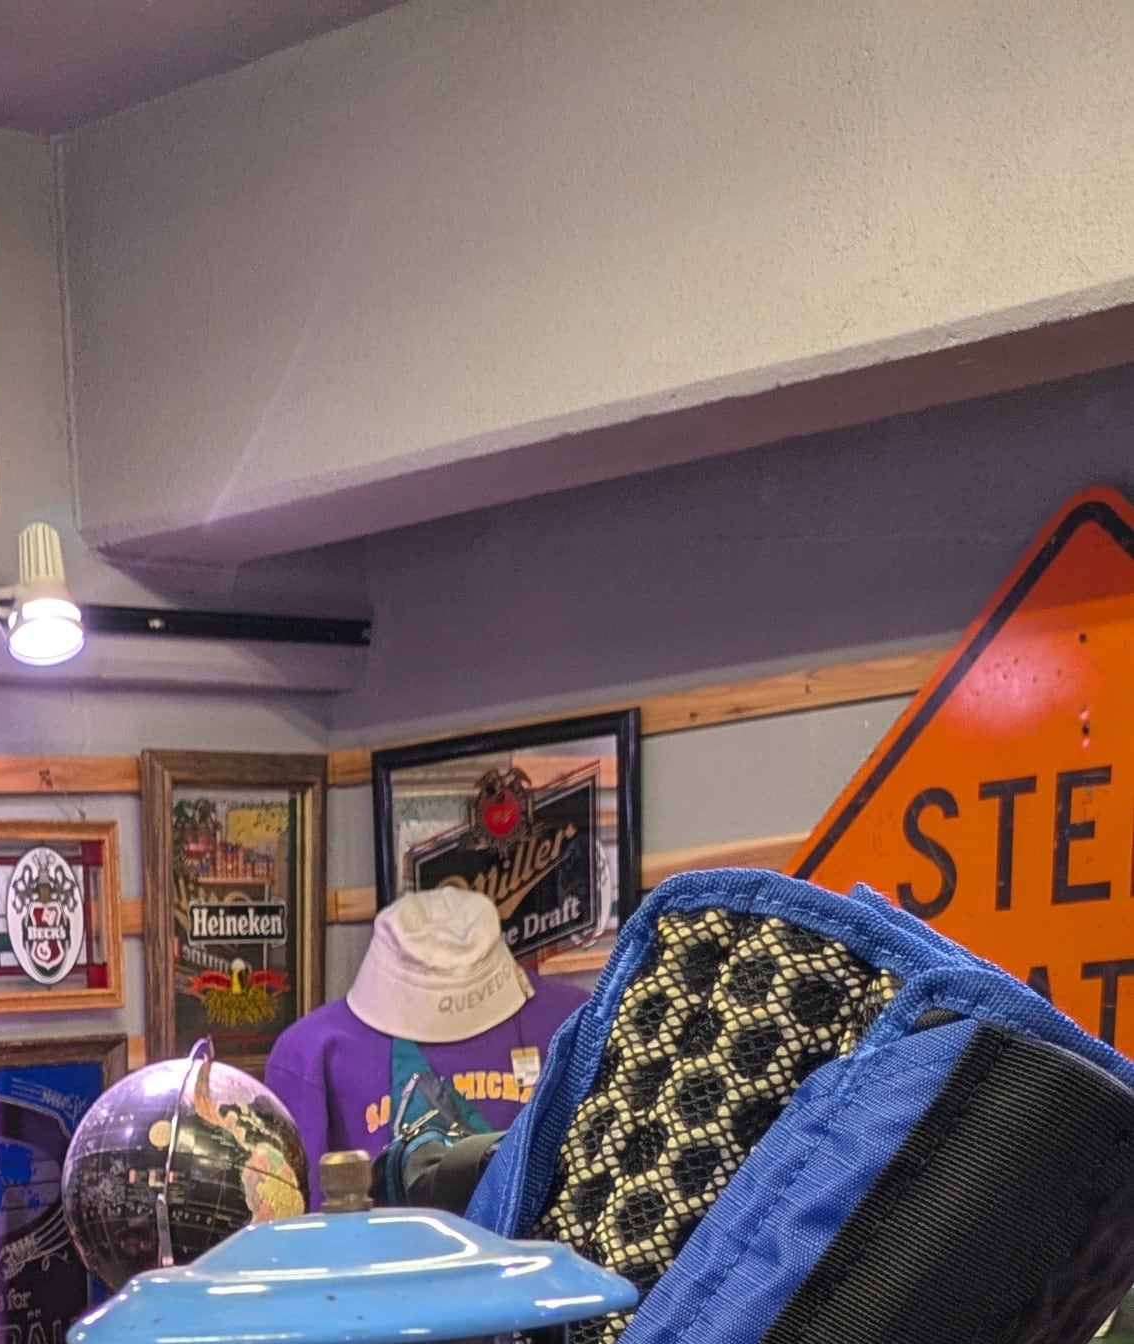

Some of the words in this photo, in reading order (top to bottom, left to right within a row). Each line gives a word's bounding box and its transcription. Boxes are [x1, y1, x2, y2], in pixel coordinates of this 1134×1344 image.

[895, 764, 1134, 921] STE
[192, 907, 285, 938] Heineken
[522, 895, 582, 941] Draft
[437, 965, 513, 1015] QUEVEDO
[452, 1070, 534, 1104] MICH
[5, 1288, 31, 1311] for
